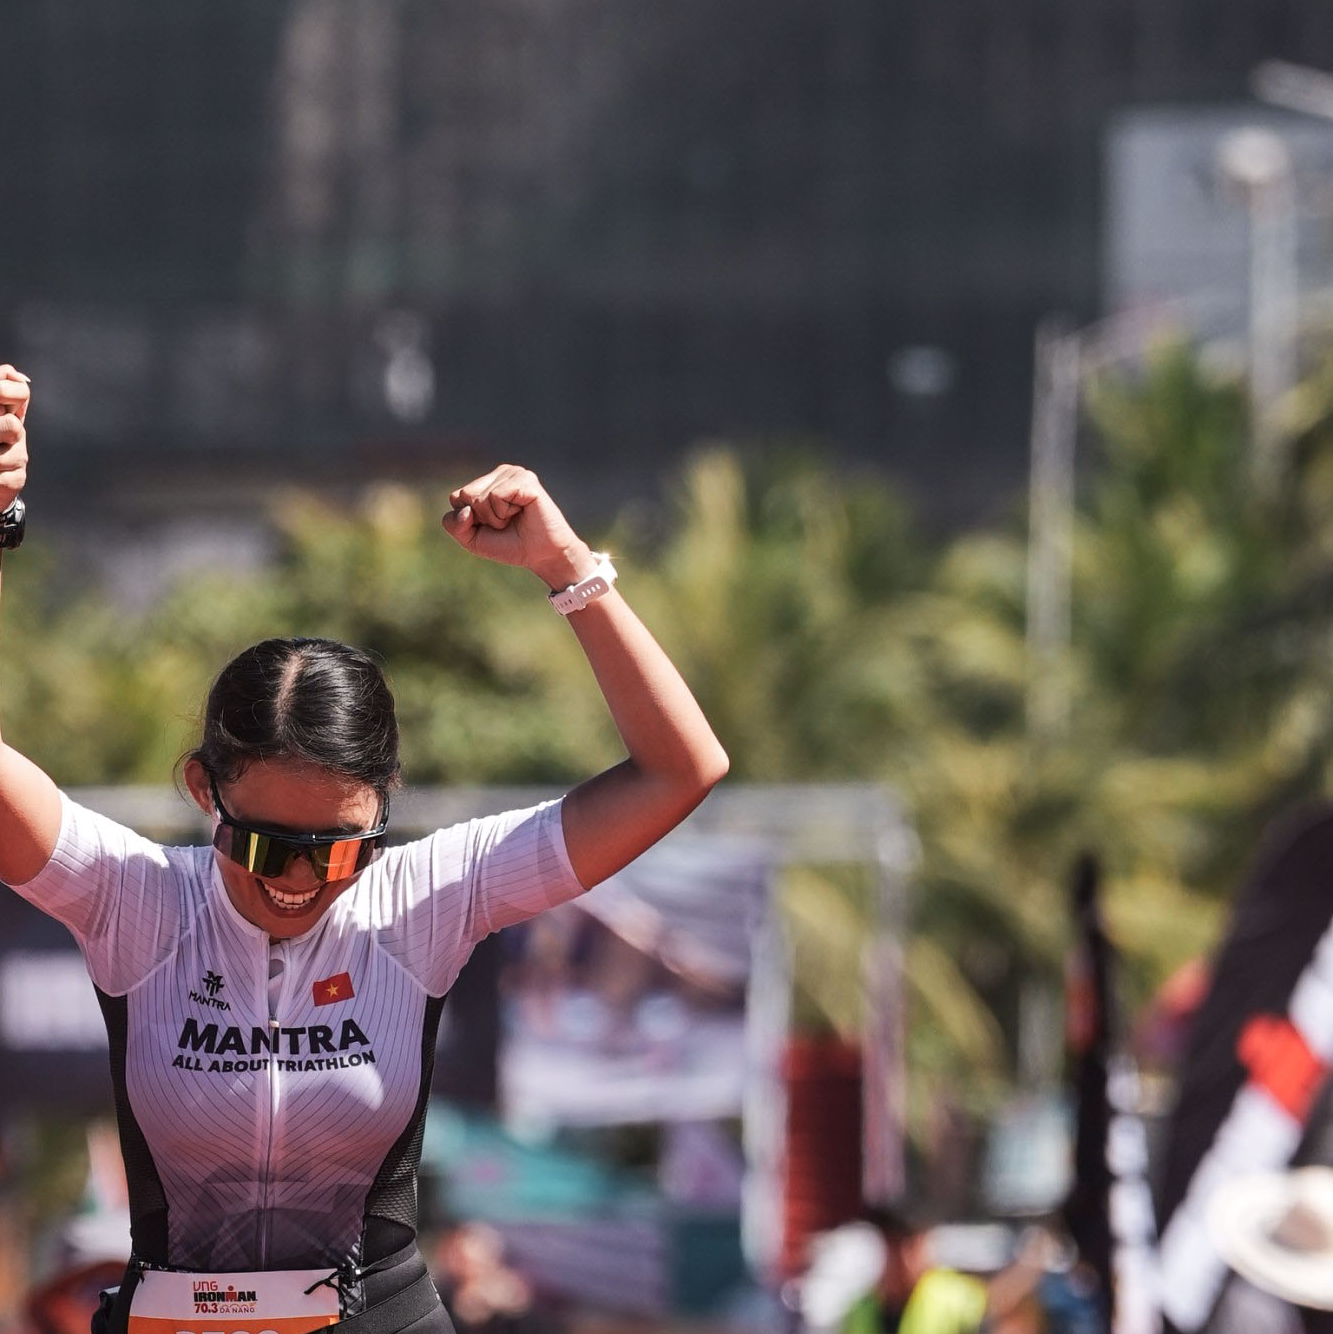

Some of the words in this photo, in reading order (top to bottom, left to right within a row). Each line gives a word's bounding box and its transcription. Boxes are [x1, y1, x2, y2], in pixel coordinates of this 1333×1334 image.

[189, 989, 231, 1011] MANTRA
[178, 1018, 370, 1055] MANTRA
[172, 1054, 203, 1071] ALL
[208, 1059, 270, 1073] ABOUT
[278, 1050, 376, 1072] TRIATHLON
[194, 1287, 257, 1302] IRONMAN
[194, 1303, 218, 1313] 70.3
